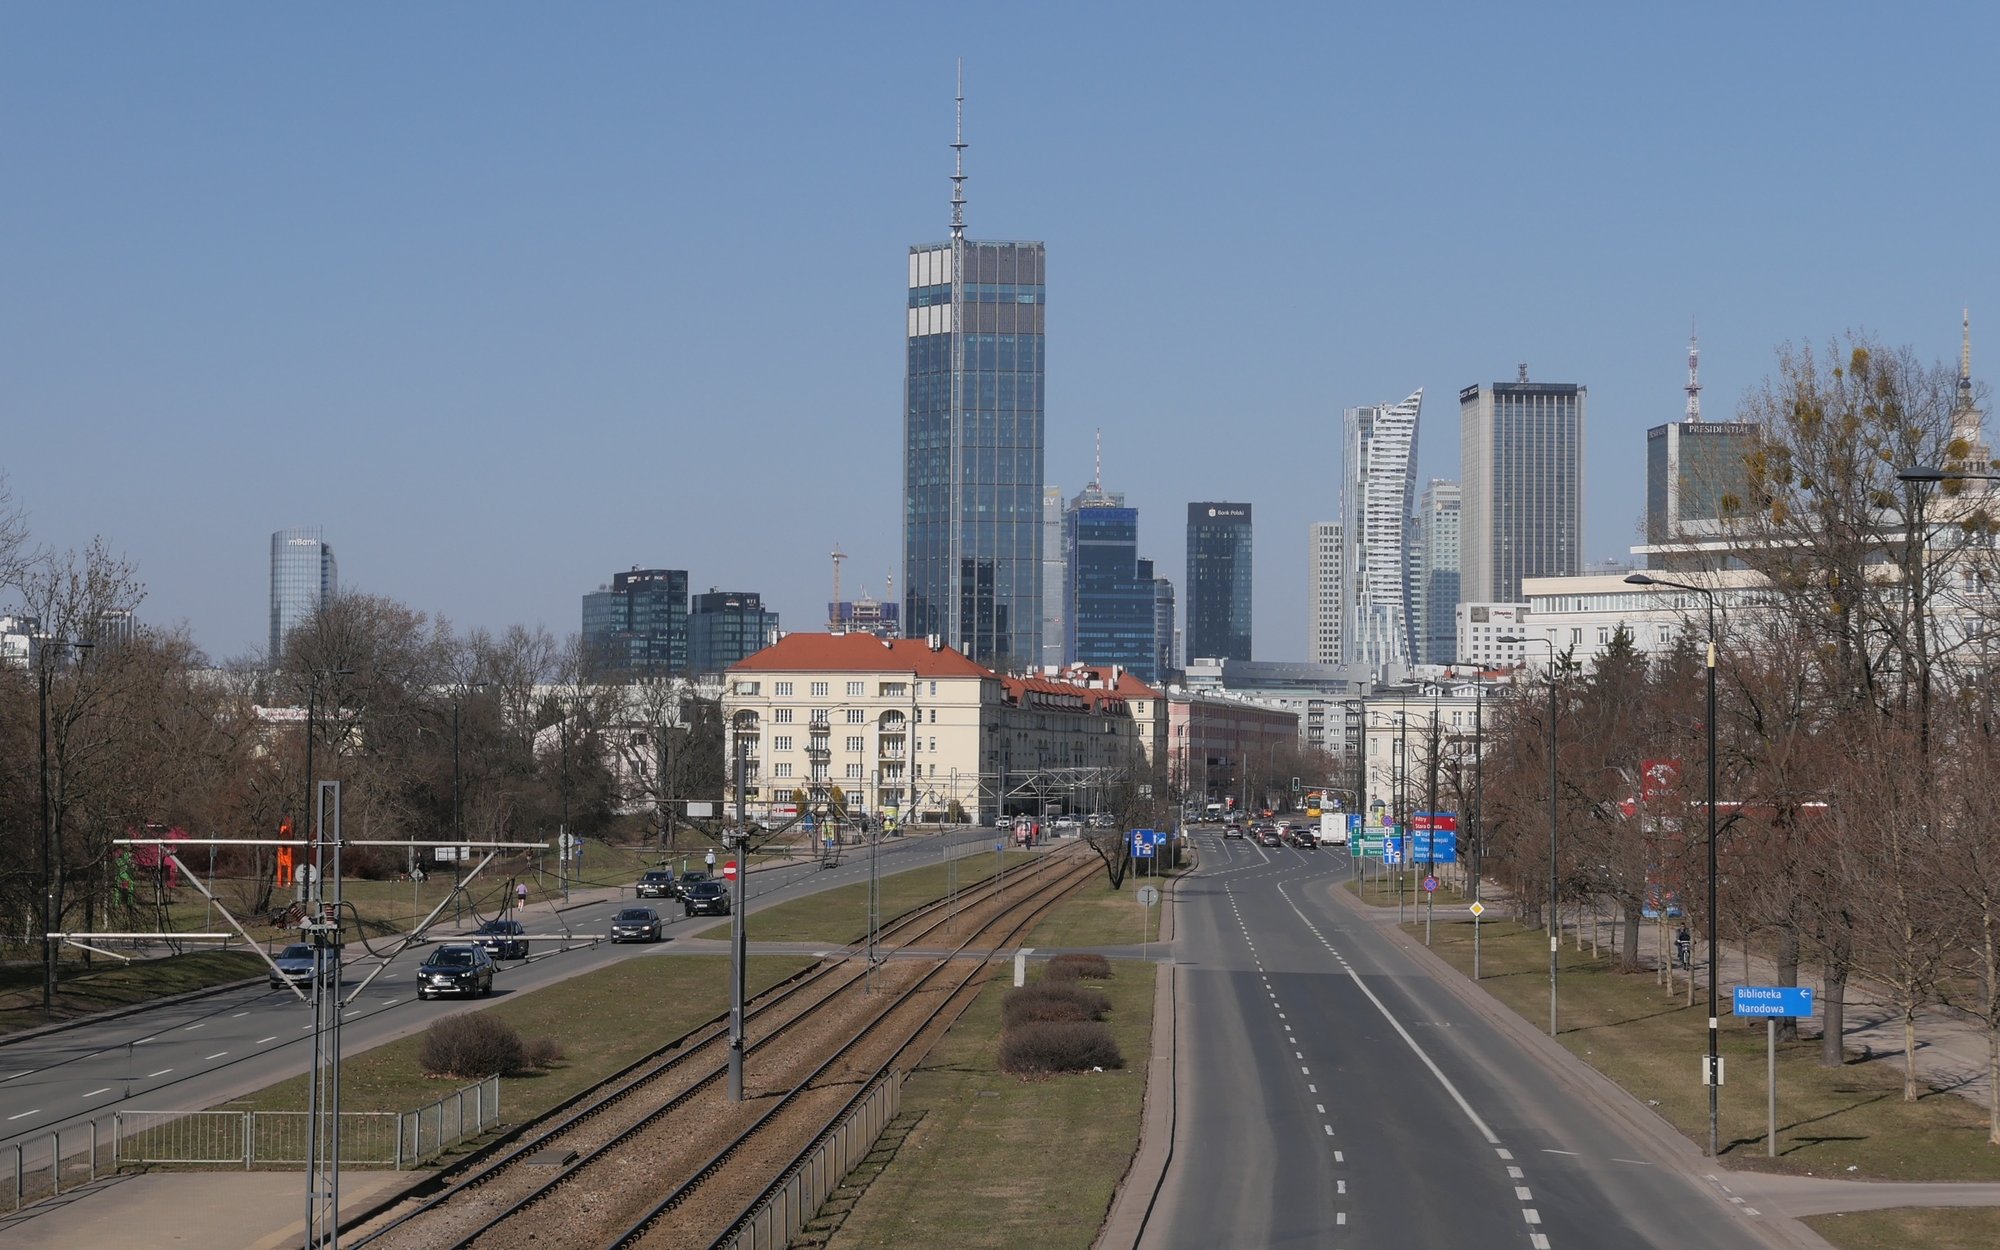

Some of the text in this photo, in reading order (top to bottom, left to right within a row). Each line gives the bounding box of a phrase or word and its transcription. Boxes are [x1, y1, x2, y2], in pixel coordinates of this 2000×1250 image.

[1043, 497, 1056, 506] EY
[1081, 510, 1136, 520] COMARCH
[288, 538, 318, 546] mBank
[1738, 988, 1782, 999] Biblioteka
[1738, 1003, 1784, 1013] Narodowa
